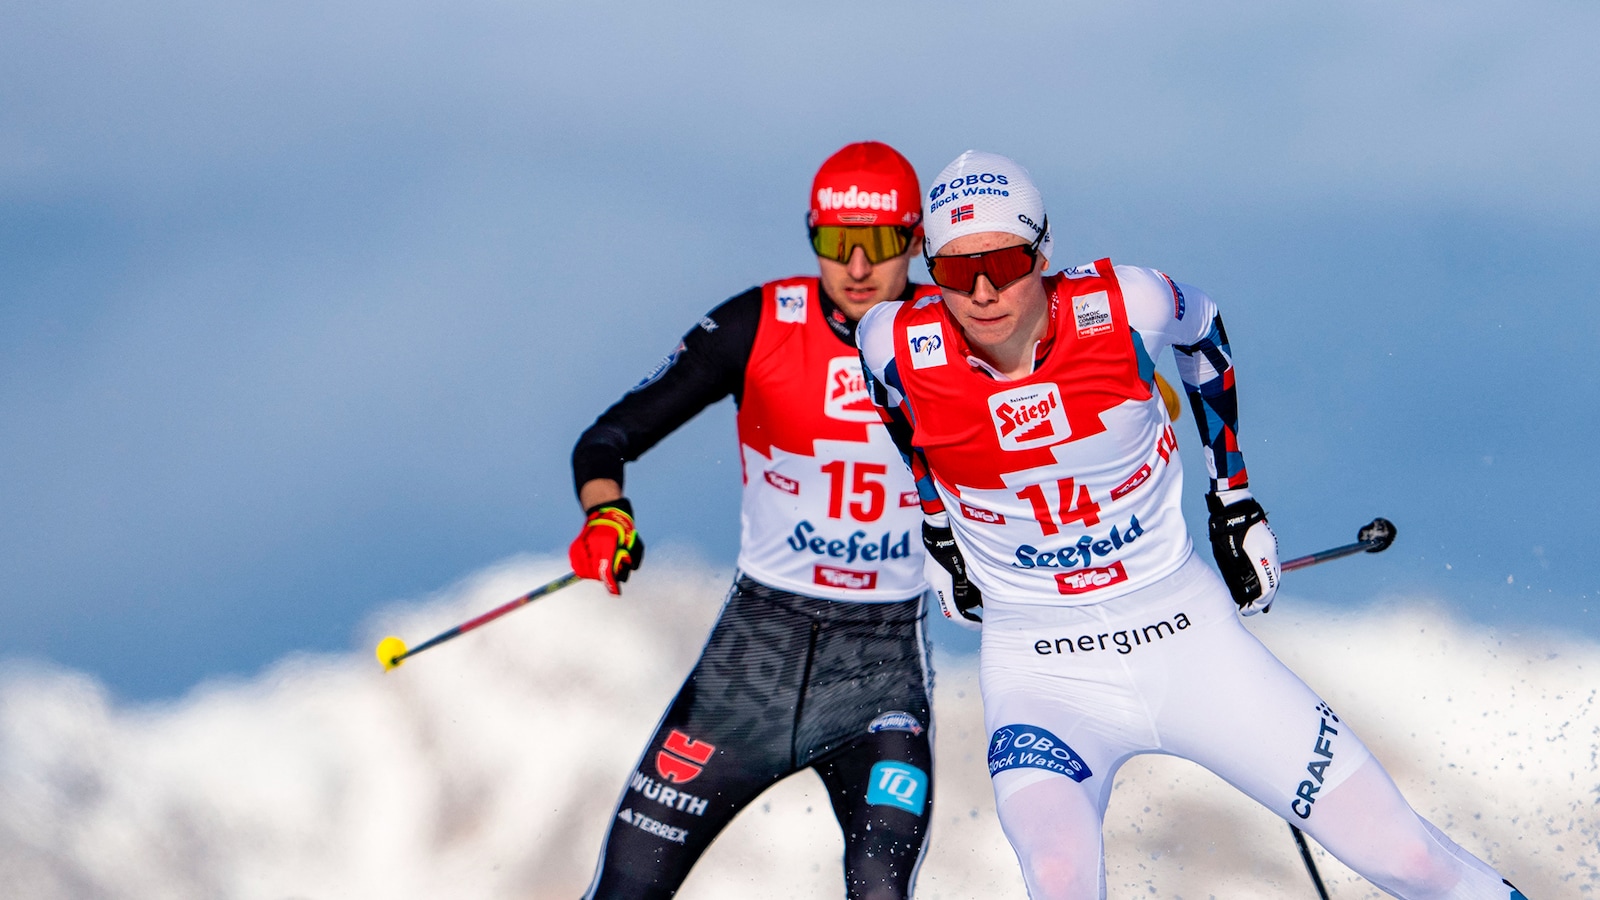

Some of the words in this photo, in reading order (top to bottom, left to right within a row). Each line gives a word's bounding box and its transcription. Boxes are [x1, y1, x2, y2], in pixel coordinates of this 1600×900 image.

[817, 184, 898, 212] Nudossi
[949, 173, 1009, 190] OBOS
[930, 192, 959, 214] Block
[962, 186, 1010, 197] Watne
[1078, 313, 1109, 324] COMBINED
[831, 368, 867, 401] Sti
[995, 390, 1057, 438] Stiegl
[820, 460, 888, 523] 15
[1016, 476, 1102, 537] 14
[964, 506, 1000, 522] Tirol
[787, 519, 911, 564] Seefeld
[1012, 514, 1145, 569] Seefeld
[819, 568, 871, 589] Tirol
[1063, 567, 1119, 589] Tirol
[1034, 612, 1192, 655] energima
[1013, 732, 1083, 772] OBOS
[1018, 751, 1075, 776] Watne
[1291, 716, 1339, 820] CRAFT
[630, 770, 710, 817] WÜRTH
[878, 767, 918, 806] TQ
[632, 811, 690, 844] TERREX
